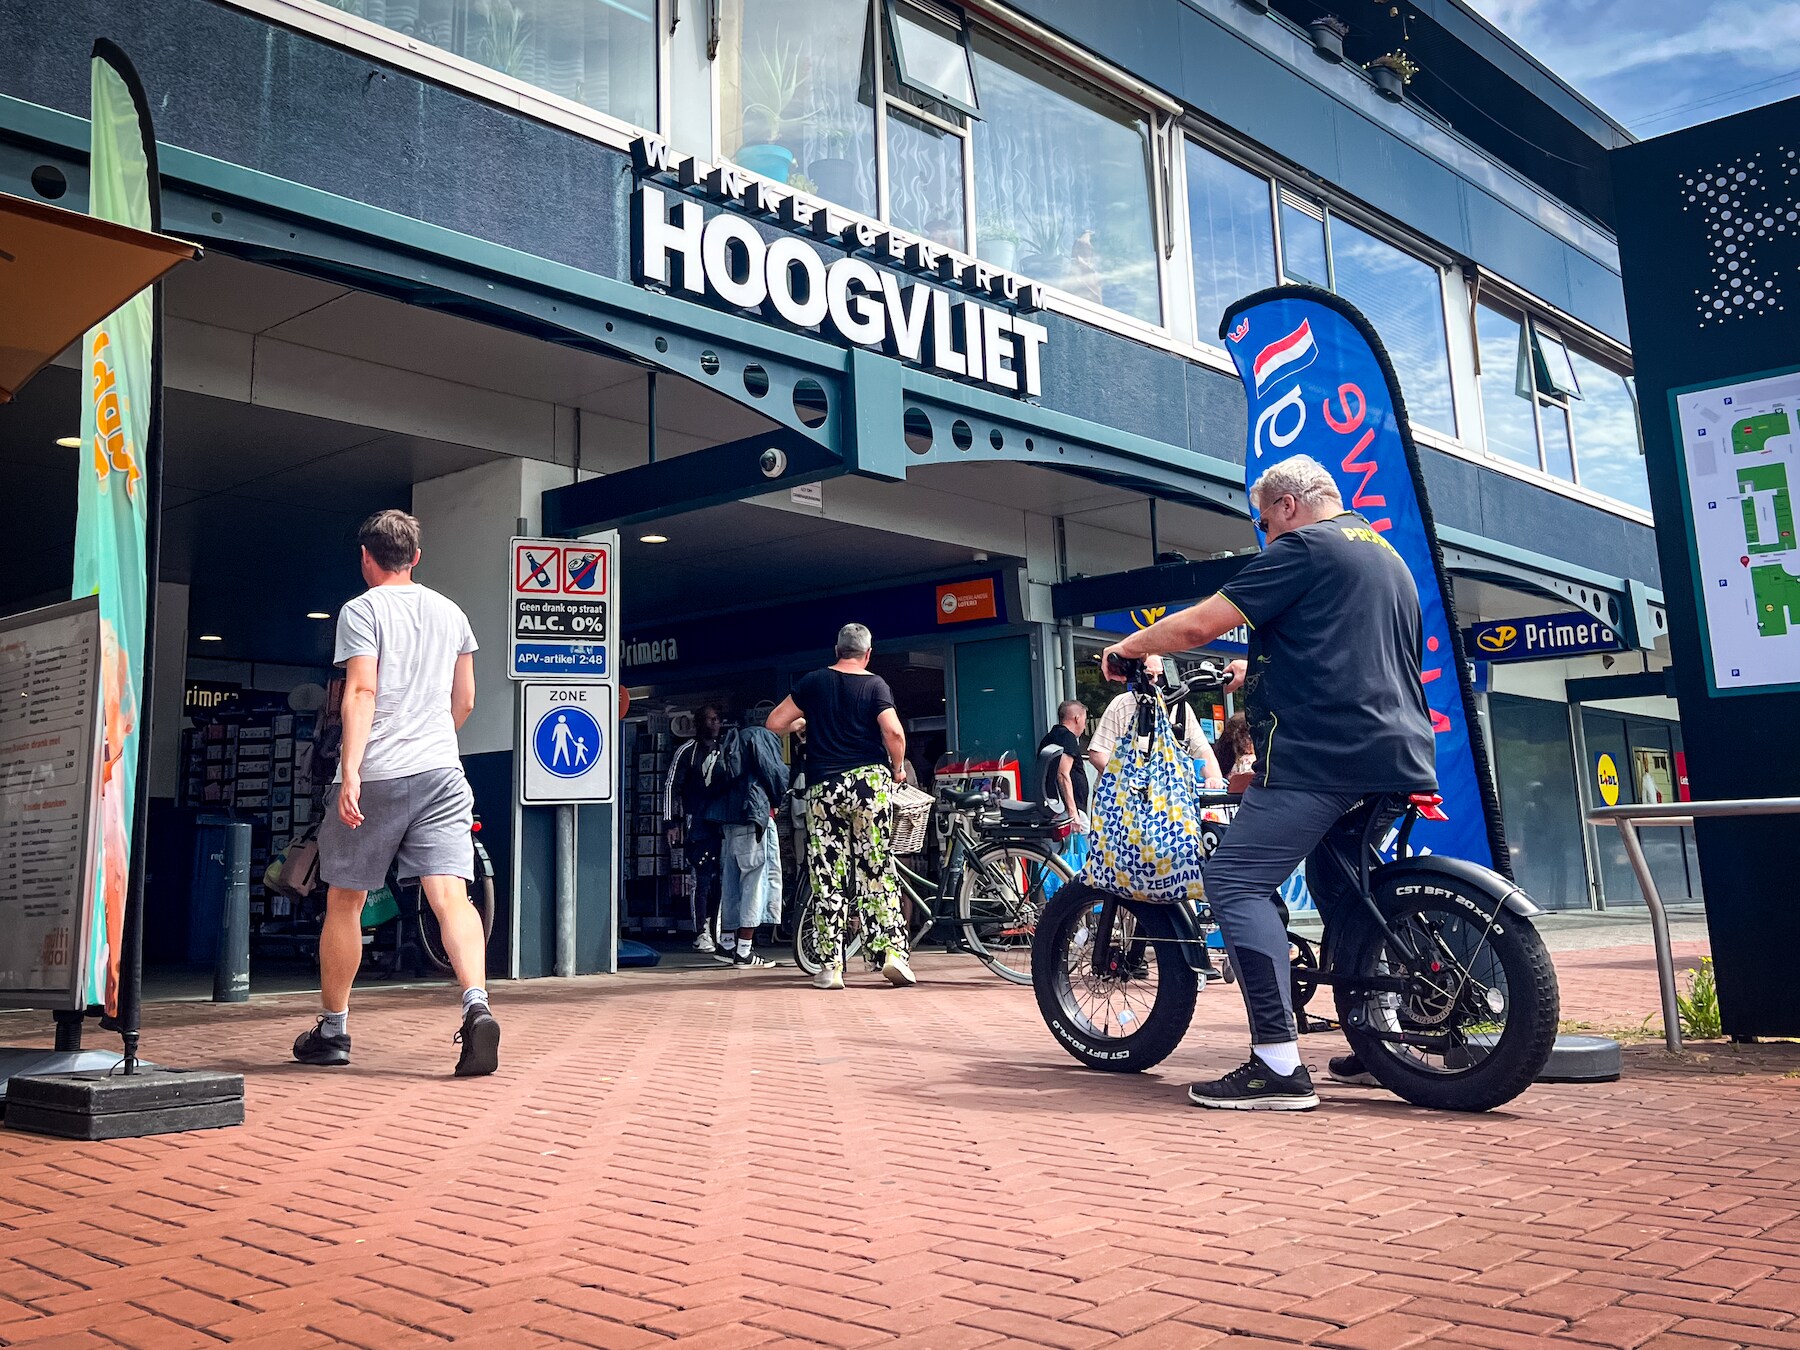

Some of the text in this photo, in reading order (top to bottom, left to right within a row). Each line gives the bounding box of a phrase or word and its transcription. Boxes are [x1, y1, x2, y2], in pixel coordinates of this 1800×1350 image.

[640, 138, 1047, 311] WINKELCENTRUM
[642, 185, 1048, 398] HOOGVLIET
[520, 602, 603, 615] Geen drank op straat
[517, 615, 603, 632] ALC. 0%
[1525, 622, 1614, 650] Primera
[517, 653, 603, 665] APV-artikel 2:48
[549, 690, 587, 701] ZONE
[1146, 869, 1200, 890] ZEEMAN
[1395, 885, 1422, 896] CST
[1424, 886, 1454, 898] BFT
[1086, 1048, 1109, 1060] BFT
[1109, 1050, 1130, 1060] CST
